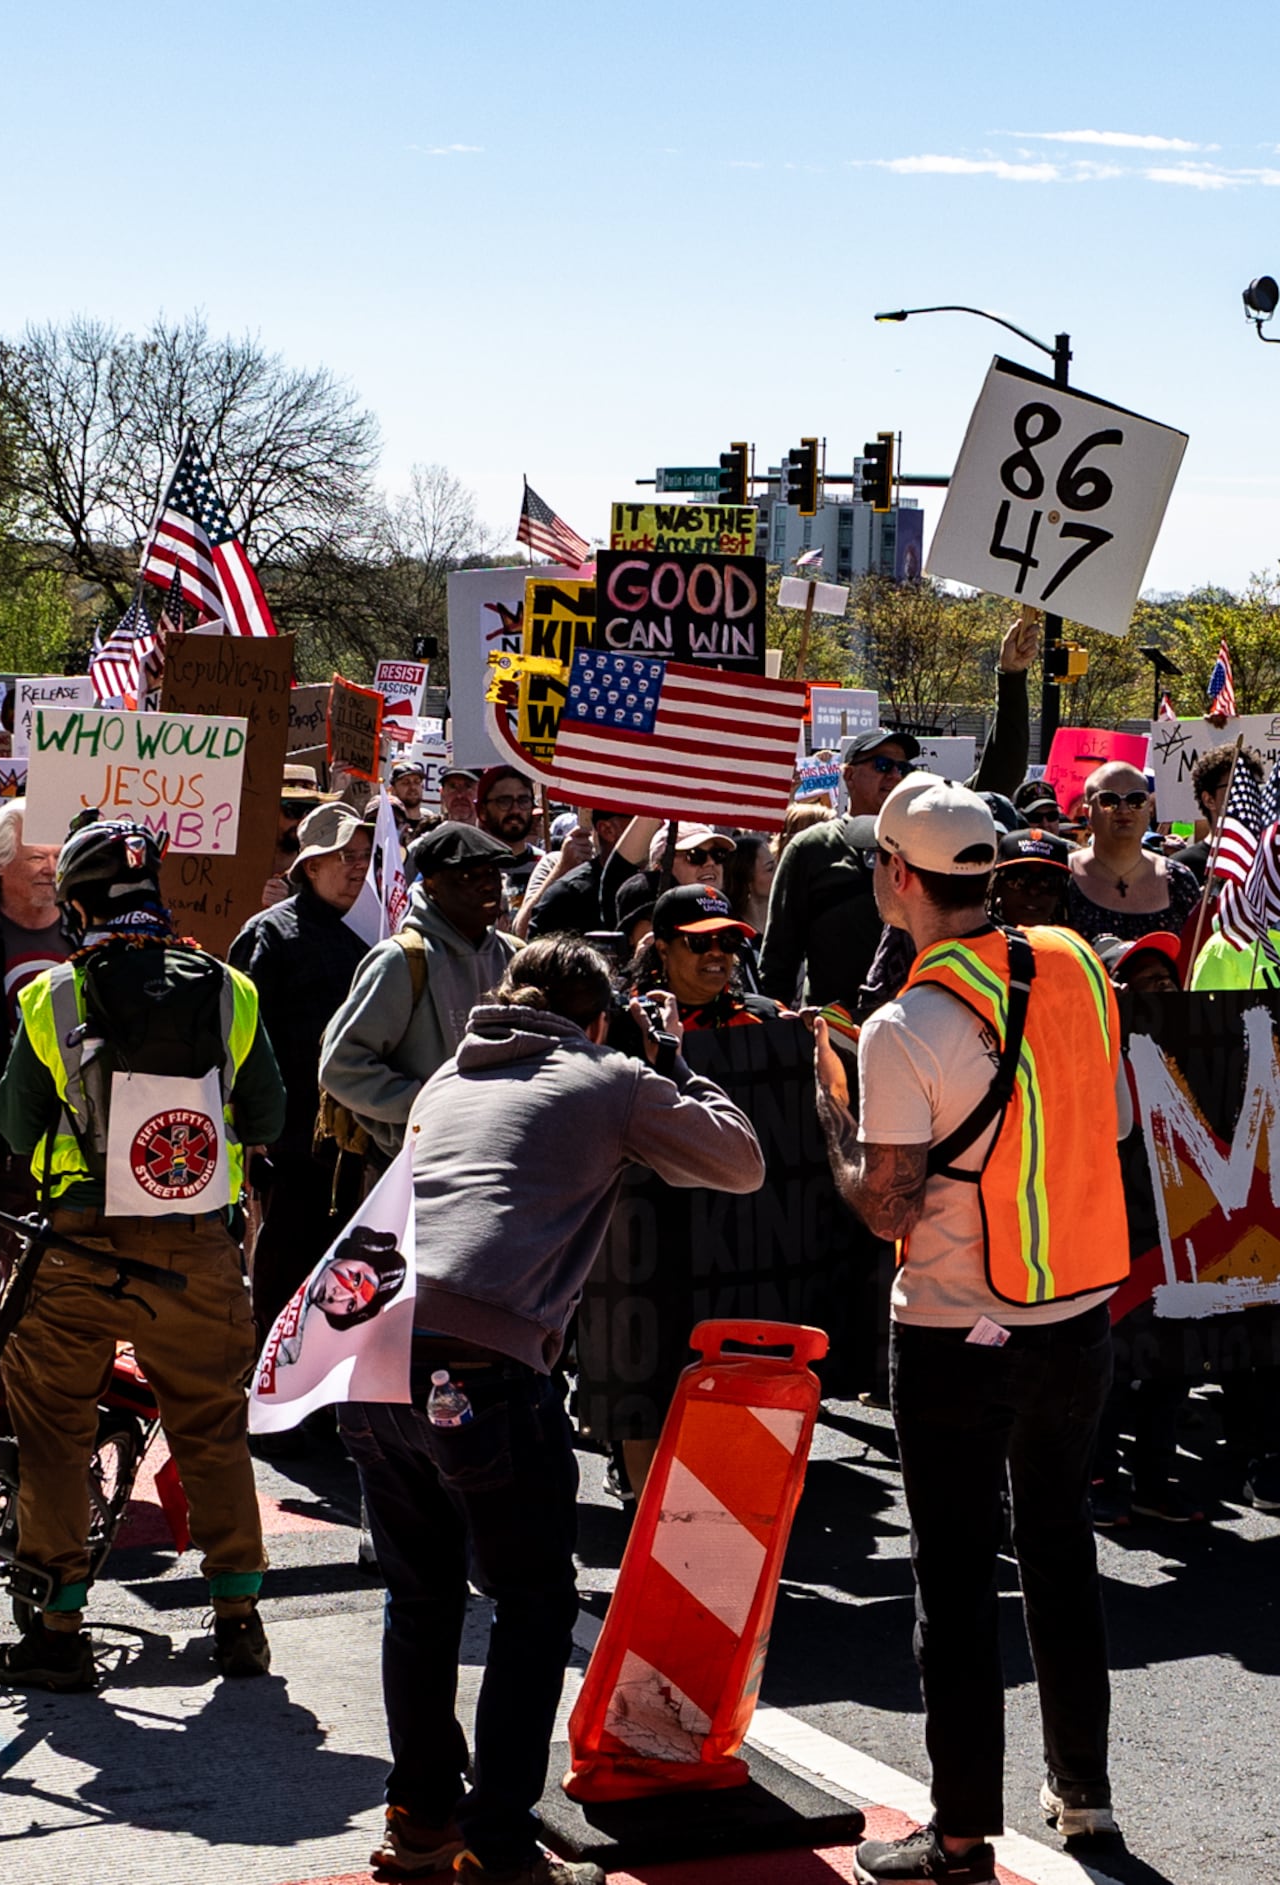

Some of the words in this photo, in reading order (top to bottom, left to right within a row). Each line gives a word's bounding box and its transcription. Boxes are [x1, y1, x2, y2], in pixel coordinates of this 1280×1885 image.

[999, 402, 1123, 511] 86
[665, 473, 682, 487] Martin
[684, 473, 702, 487] Luther
[704, 473, 717, 490] King
[616, 505, 644, 531] IT
[655, 505, 703, 533] WAS
[703, 507, 754, 533] THE
[989, 500, 1114, 602] 47
[607, 560, 757, 619] GOOD
[605, 616, 673, 651] CAN
[689, 622, 756, 657] WIN
[377, 681, 418, 697] FASCISM
[380, 667, 422, 682] RESIST
[21, 684, 81, 705] RELEASE
[36, 710, 124, 758] WHO
[136, 719, 245, 760] WOULD
[81, 764, 204, 809] JESUS
[181, 855, 214, 886] OR
[136, 1116, 166, 1147] FIFTY
[168, 1111, 205, 1126] FIFTY
[203, 1120, 216, 1143] ONE
[135, 1164, 180, 1198] STREET
[182, 1159, 216, 1197] MEDIC
